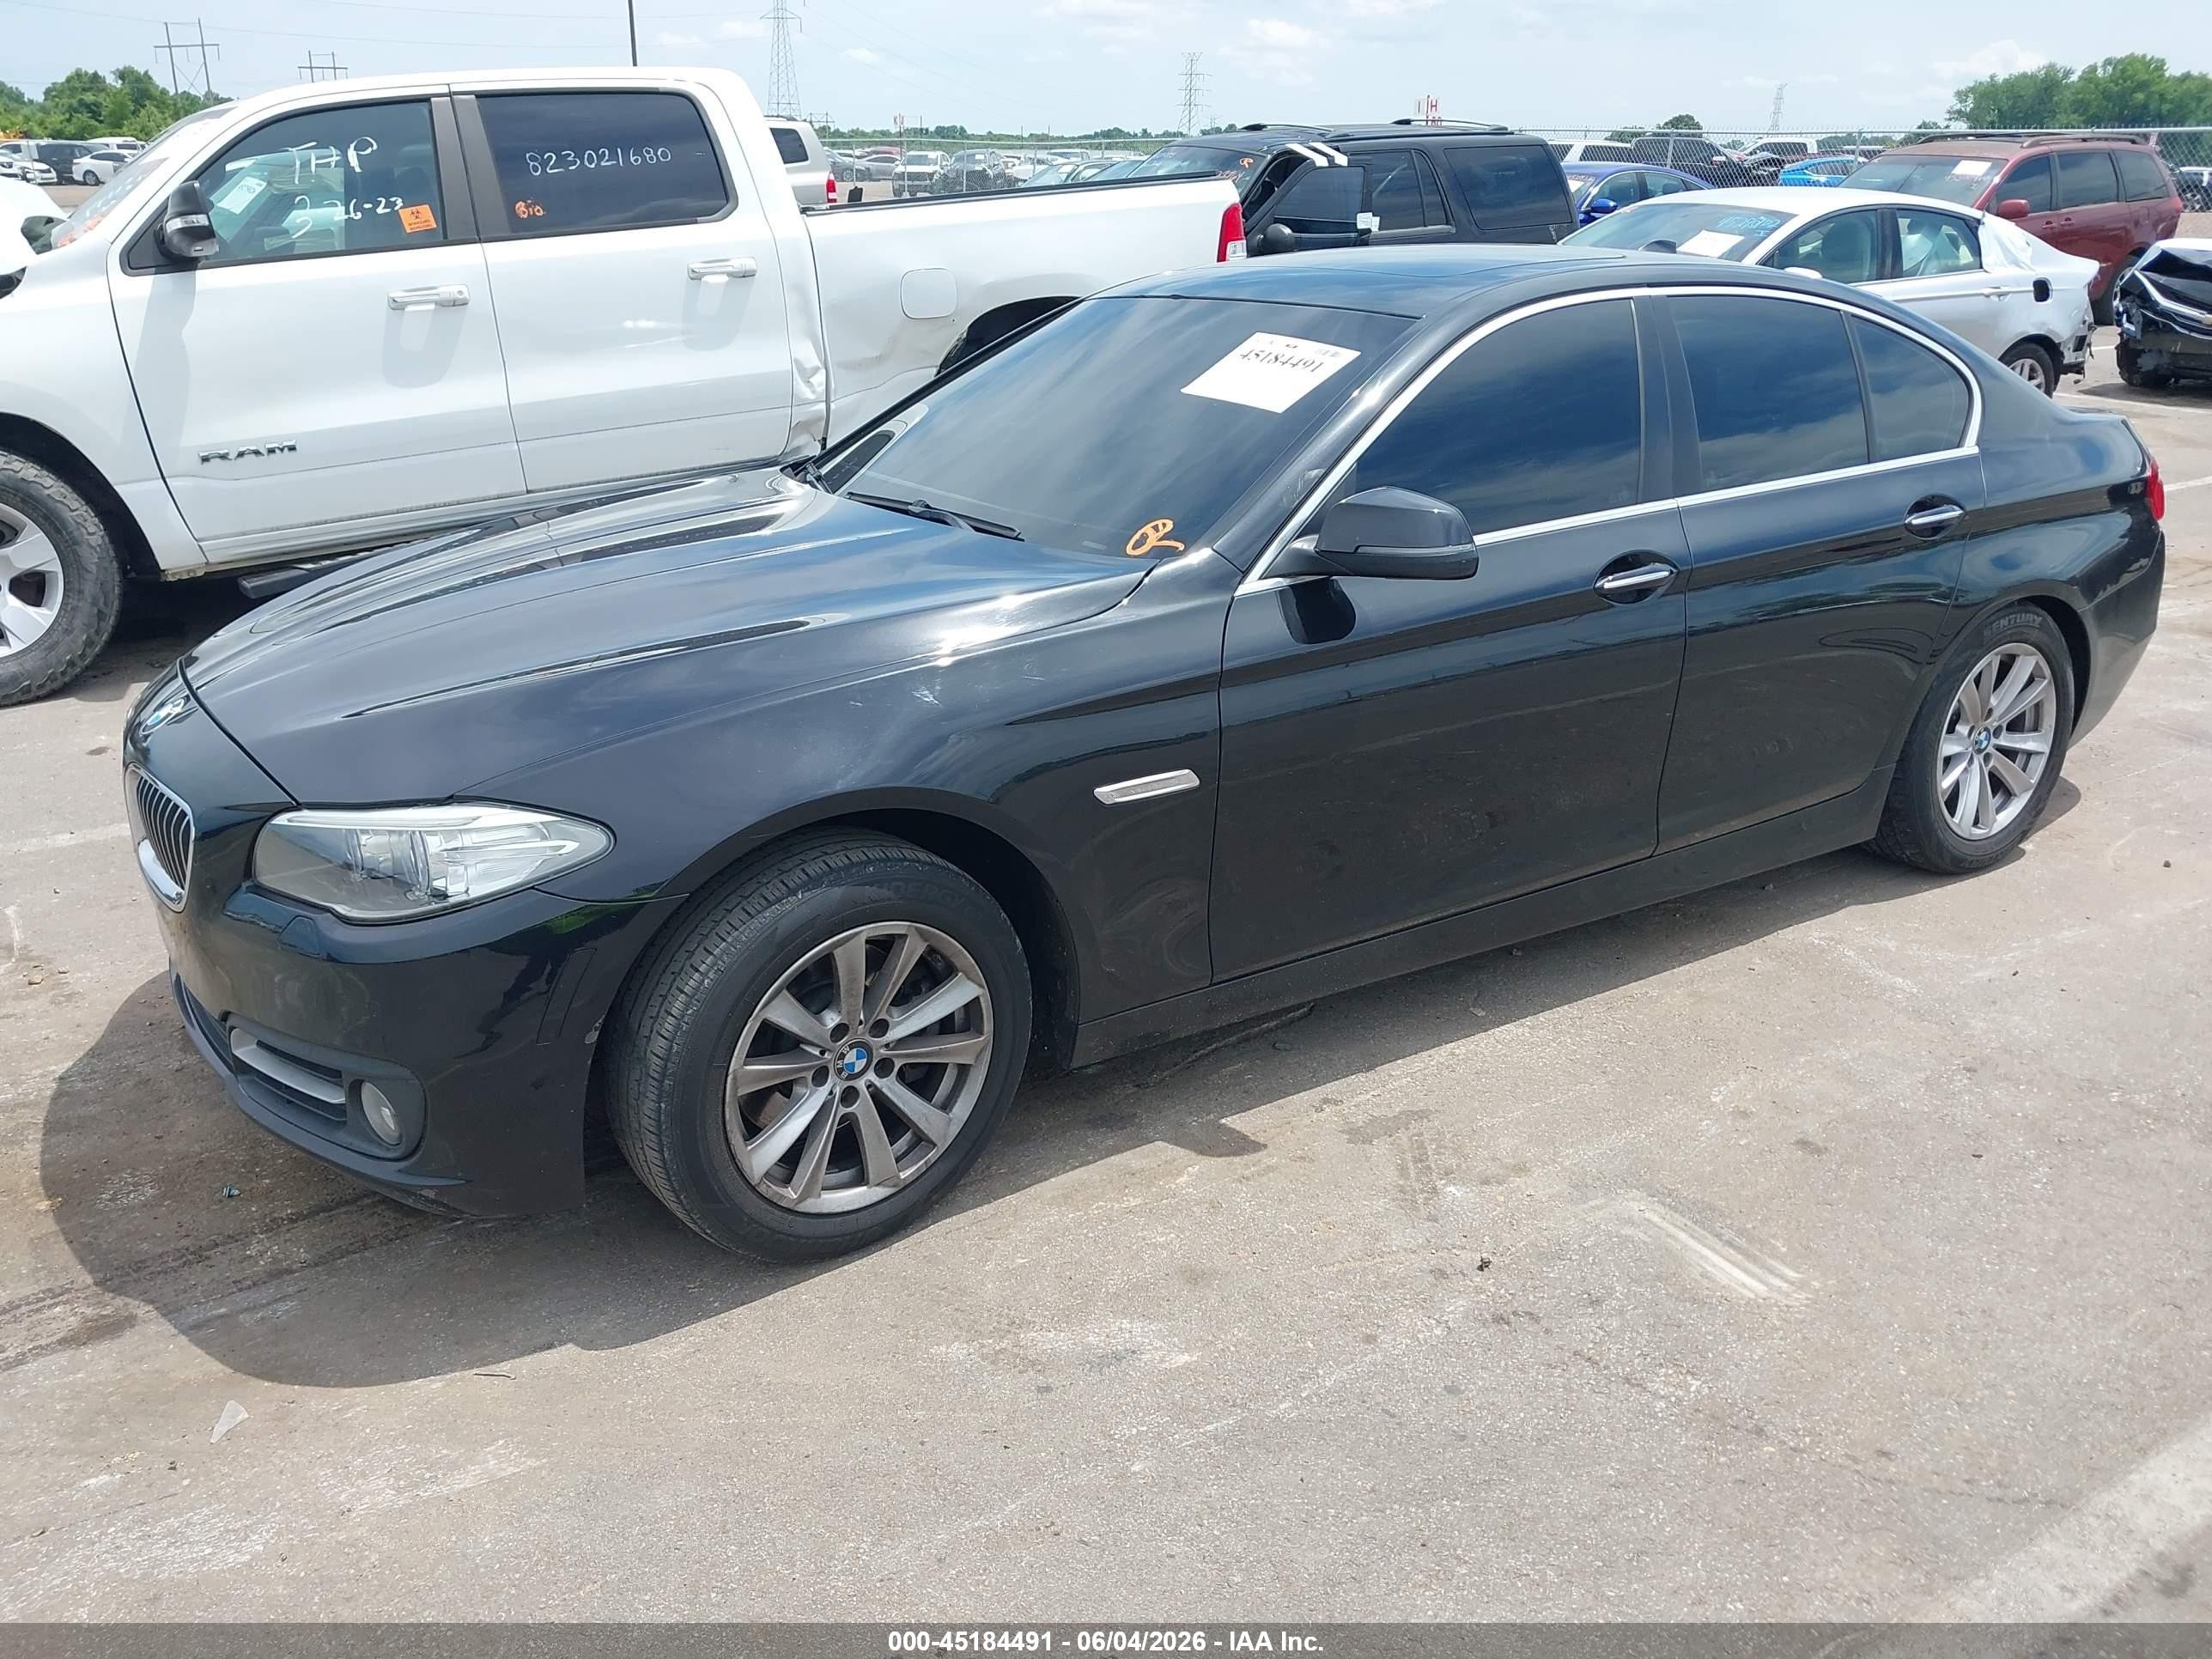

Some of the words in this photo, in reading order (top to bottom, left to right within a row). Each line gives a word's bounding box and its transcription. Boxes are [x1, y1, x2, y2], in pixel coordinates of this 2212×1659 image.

[526, 147, 672, 176] 823021680
[1239, 349, 1325, 373] 45184491
[198, 439, 296, 465] RAM
